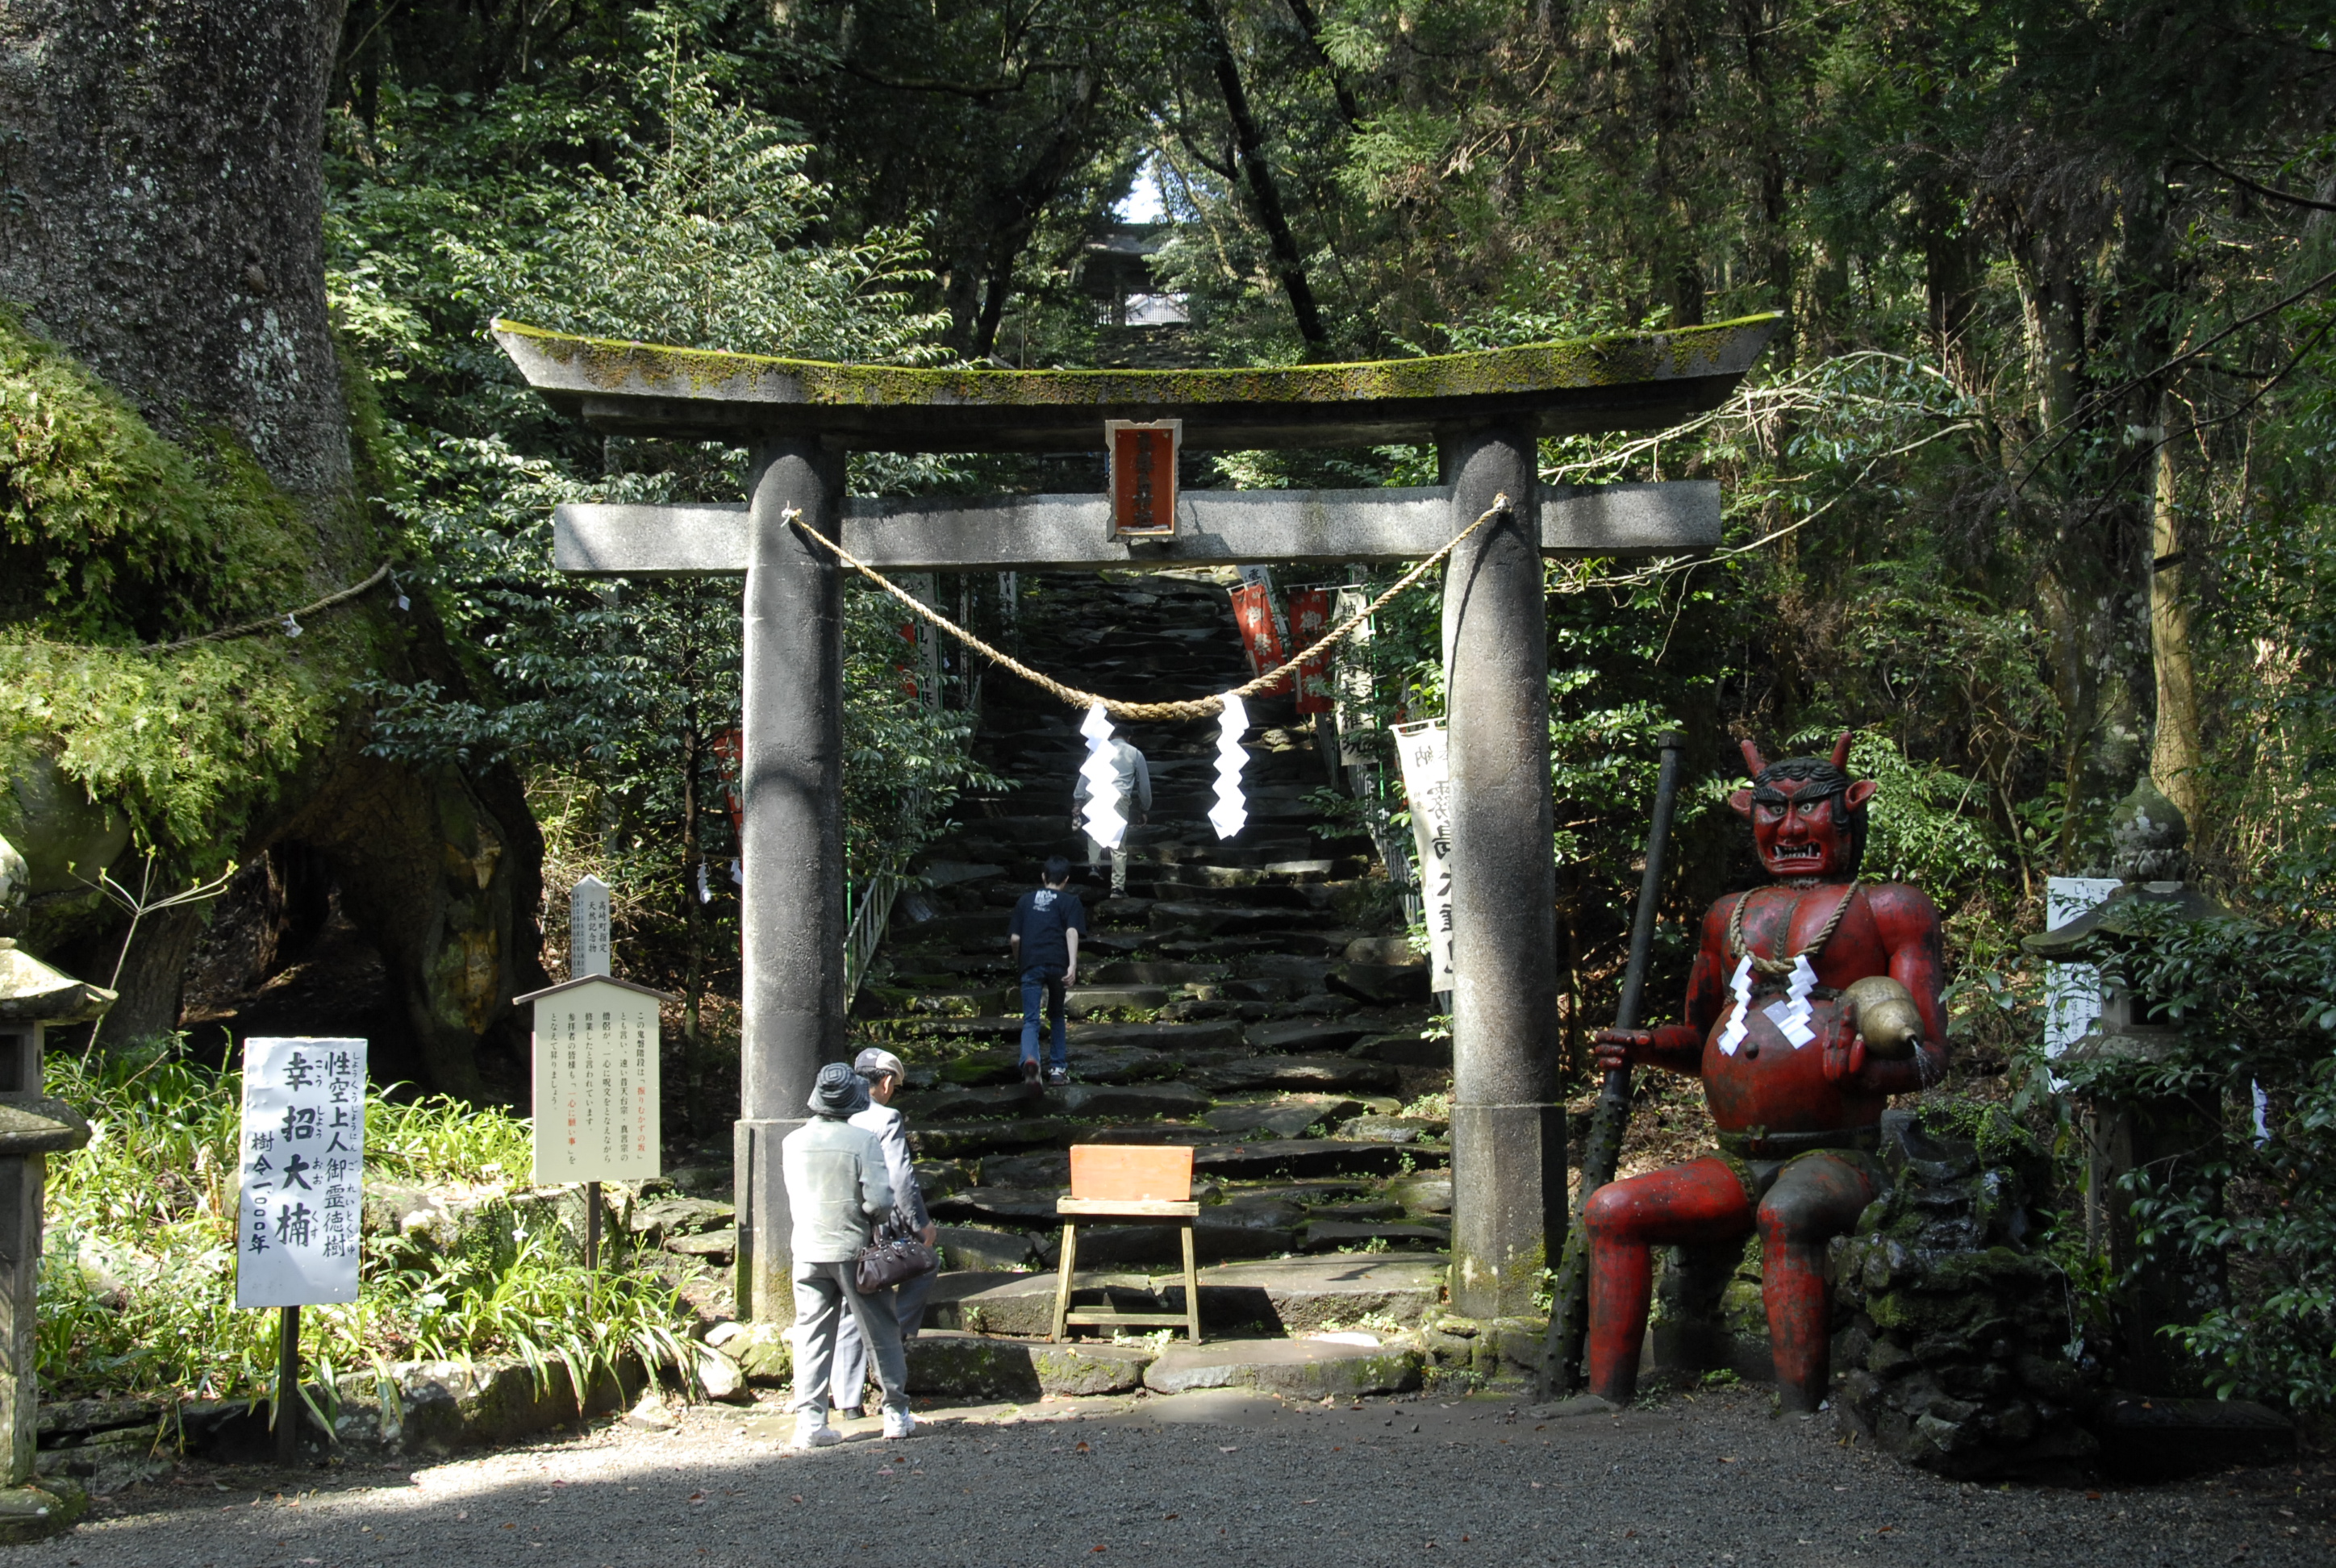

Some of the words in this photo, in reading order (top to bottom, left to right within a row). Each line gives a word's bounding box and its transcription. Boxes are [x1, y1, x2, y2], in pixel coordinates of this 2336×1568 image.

[588, 901, 598, 953] 天然記念物
[598, 900, 607, 953] 高崎町指定
[550, 1012, 558, 1111] となえて昇りましょう。
[567, 1011, 577, 1165] 参拝者の皆様も「一心に願い事」を
[585, 1011, 594, 1131] 修業したと言われています。
[602, 1011, 611, 1163] 僧侶が、一心に呪文をとなえながら
[274, 1051, 315, 1248] 幸招大楠
[323, 1051, 351, 1257] 性空上人御霊徳樹
